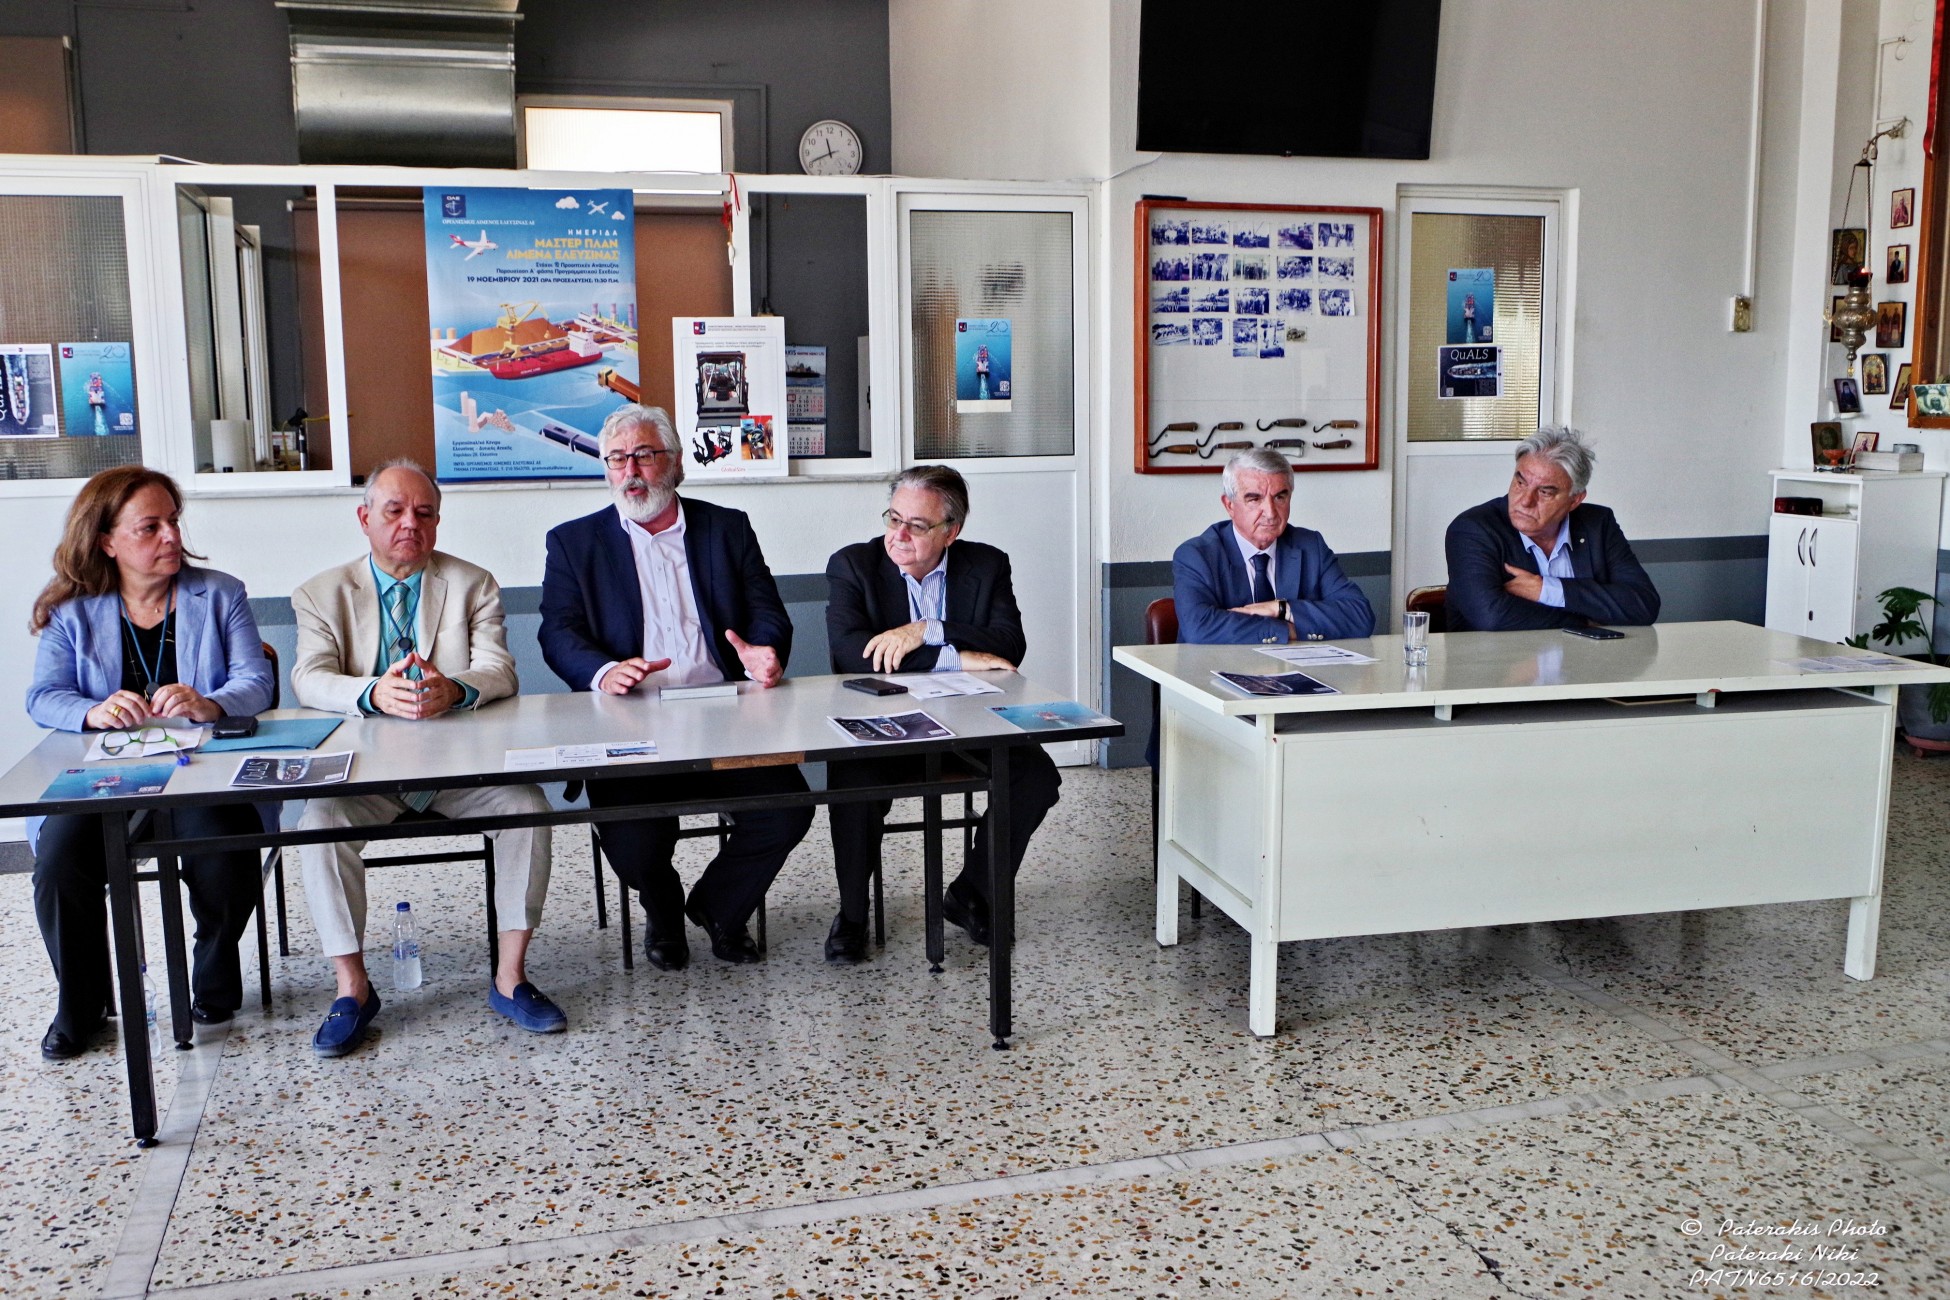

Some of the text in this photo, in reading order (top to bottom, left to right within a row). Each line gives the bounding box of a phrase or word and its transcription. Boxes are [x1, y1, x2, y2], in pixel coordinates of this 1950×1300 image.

[534, 238, 618, 248] ΜΑΣΤΕΡ ΠΛΑΝ
[506, 249, 620, 260] ΛΙΜΕΝΑ ΕΛΕΥΣΙΝΑΣ
[1450, 349, 1490, 362] QuALS
